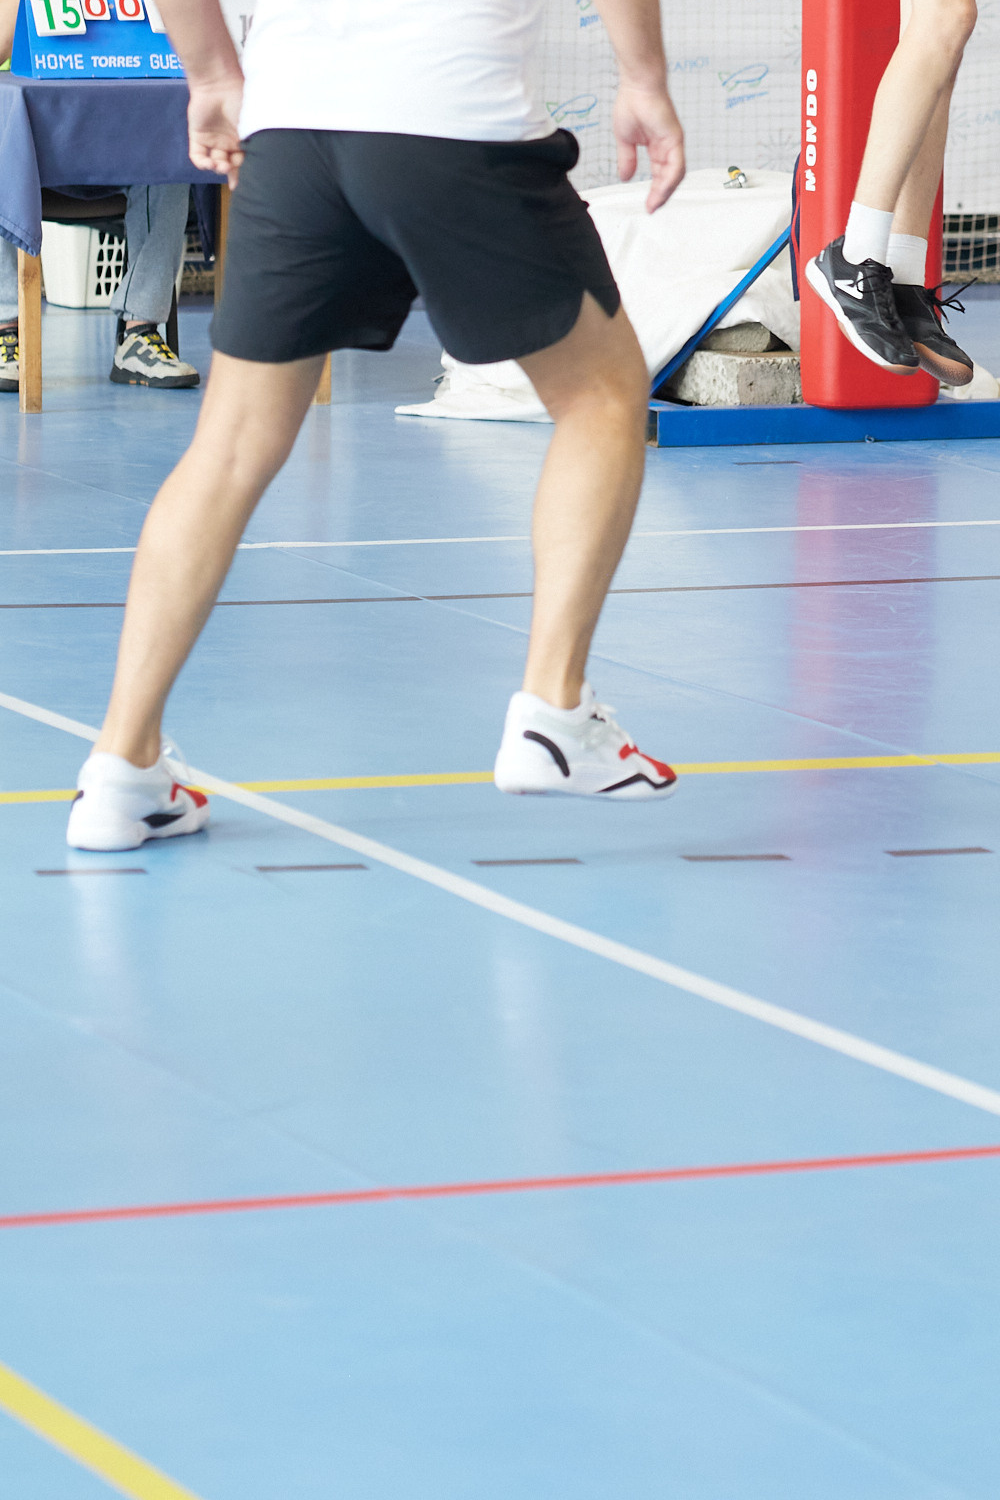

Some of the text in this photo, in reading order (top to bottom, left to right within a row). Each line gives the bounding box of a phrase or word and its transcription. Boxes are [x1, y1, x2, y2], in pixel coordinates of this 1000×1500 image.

[34, 53, 84, 70] HOME
[91, 56, 142, 68] TORRES
[804, 68, 818, 192] MONDO
